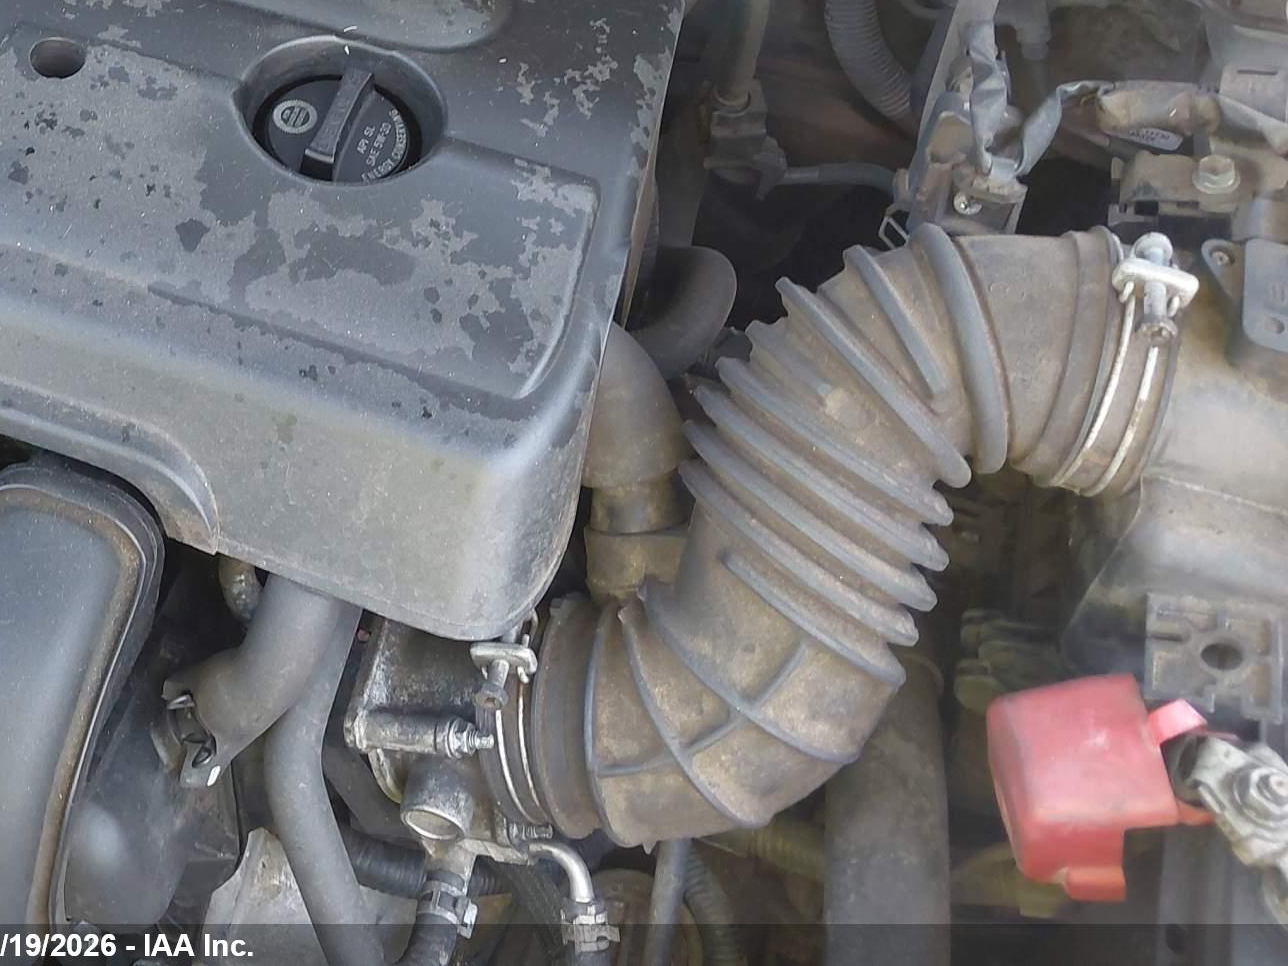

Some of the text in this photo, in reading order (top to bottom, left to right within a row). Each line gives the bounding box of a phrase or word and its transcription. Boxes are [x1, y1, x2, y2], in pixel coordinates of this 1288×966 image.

[357, 126, 376, 154] API SL
[366, 147, 379, 166] SAE
